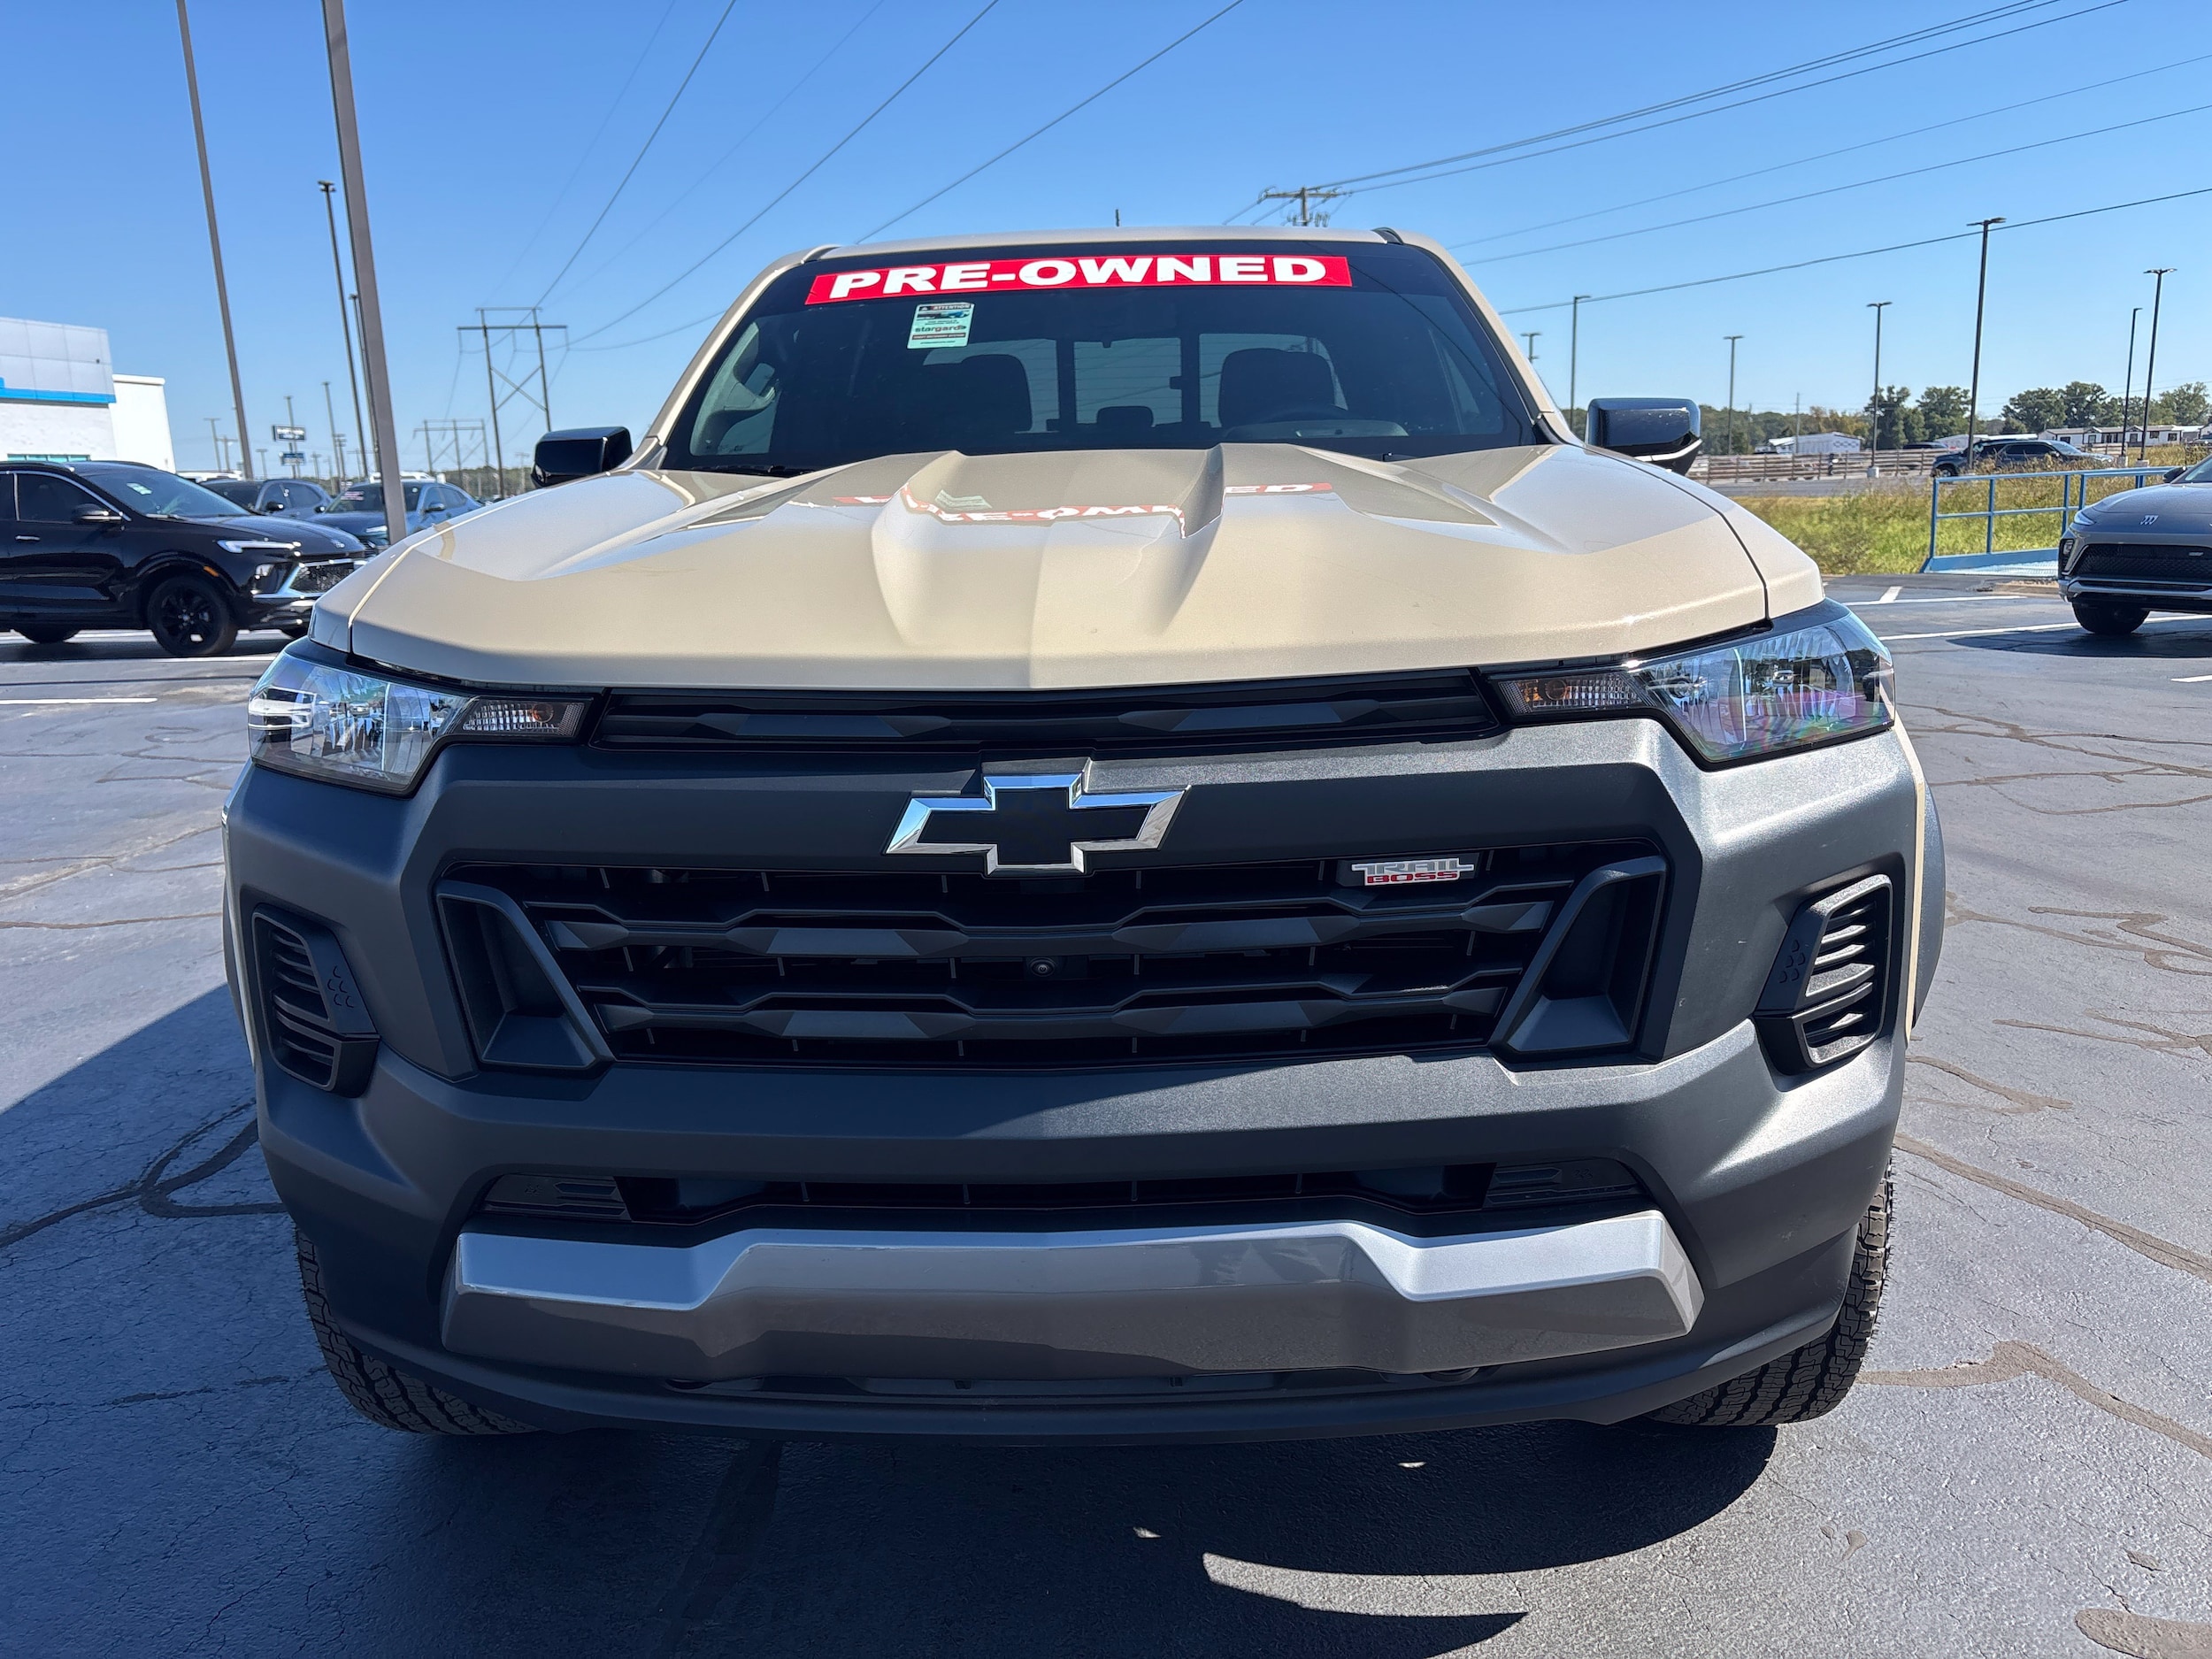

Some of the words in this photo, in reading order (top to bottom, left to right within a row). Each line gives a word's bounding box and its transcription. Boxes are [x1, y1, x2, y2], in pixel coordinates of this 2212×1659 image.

[829, 257, 1327, 299] PRE-OWNED
[1351, 858, 1474, 875] TRAIL
[1366, 871, 1458, 884] BOSS
